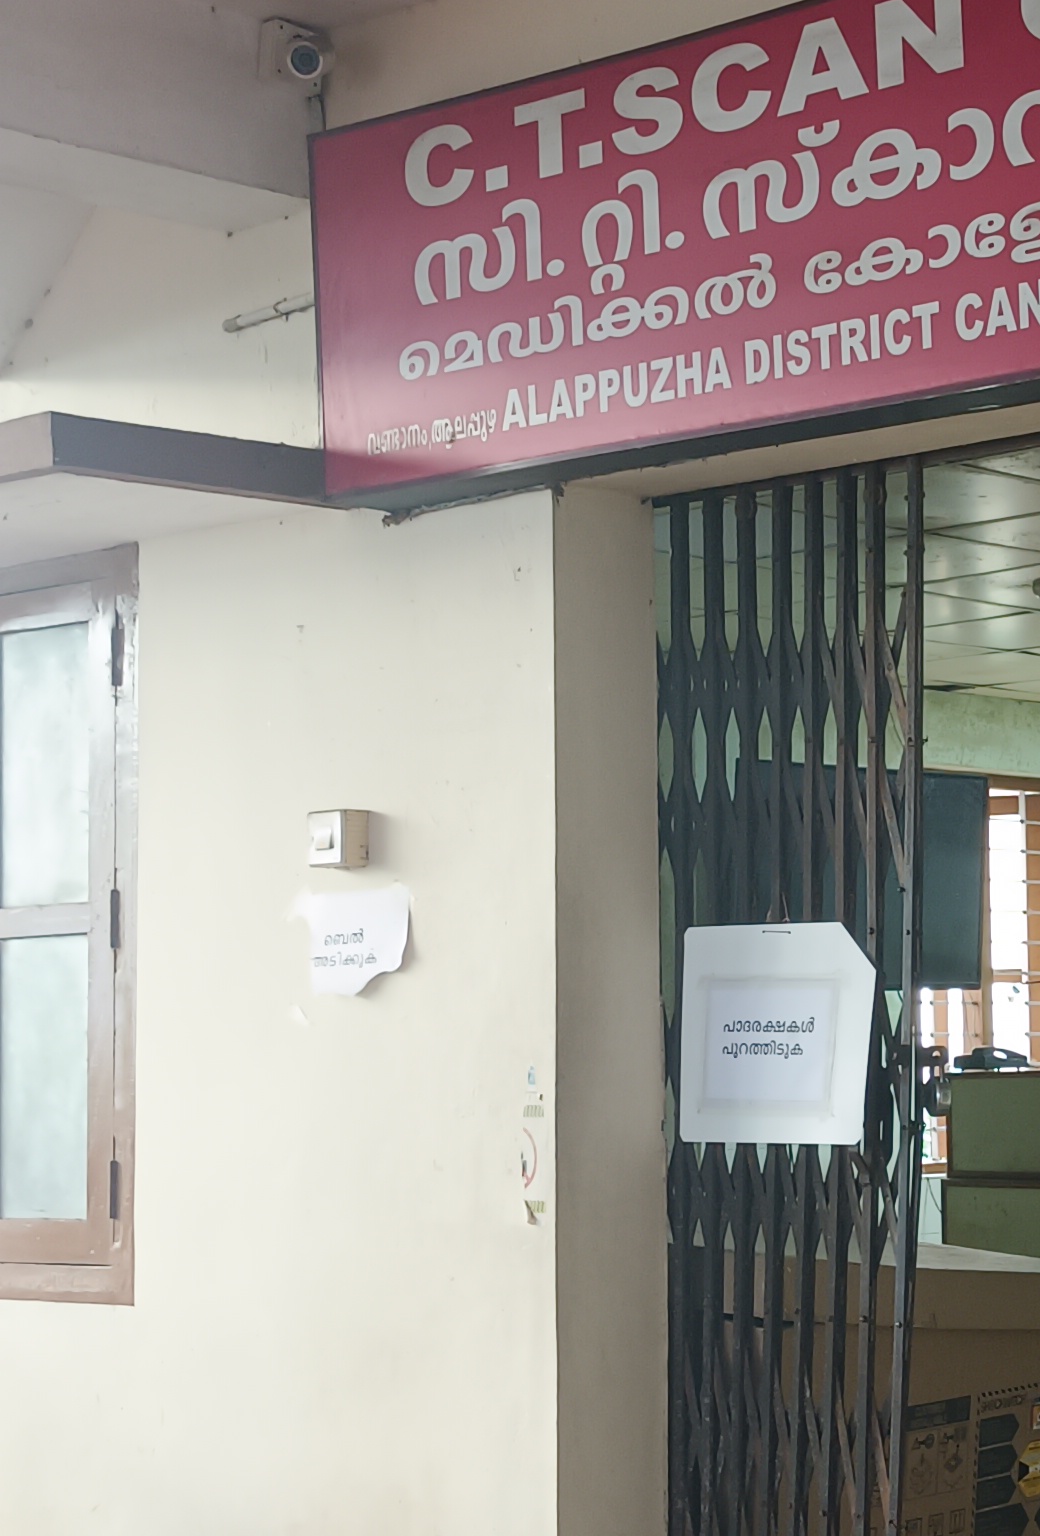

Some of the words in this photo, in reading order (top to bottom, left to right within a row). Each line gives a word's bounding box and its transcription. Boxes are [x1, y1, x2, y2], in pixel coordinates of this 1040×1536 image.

[400, 252, 777, 380] മെഡിക്കൽ
[502, 351, 731, 431] ALAPPUZHA
[745, 301, 939, 387] DISTRICT
[324, 928, 364, 946] ബെൽ
[723, 1016, 815, 1033] പാദരക്ഷകൾ
[722, 1040, 804, 1059] പുറത്തിടുക
